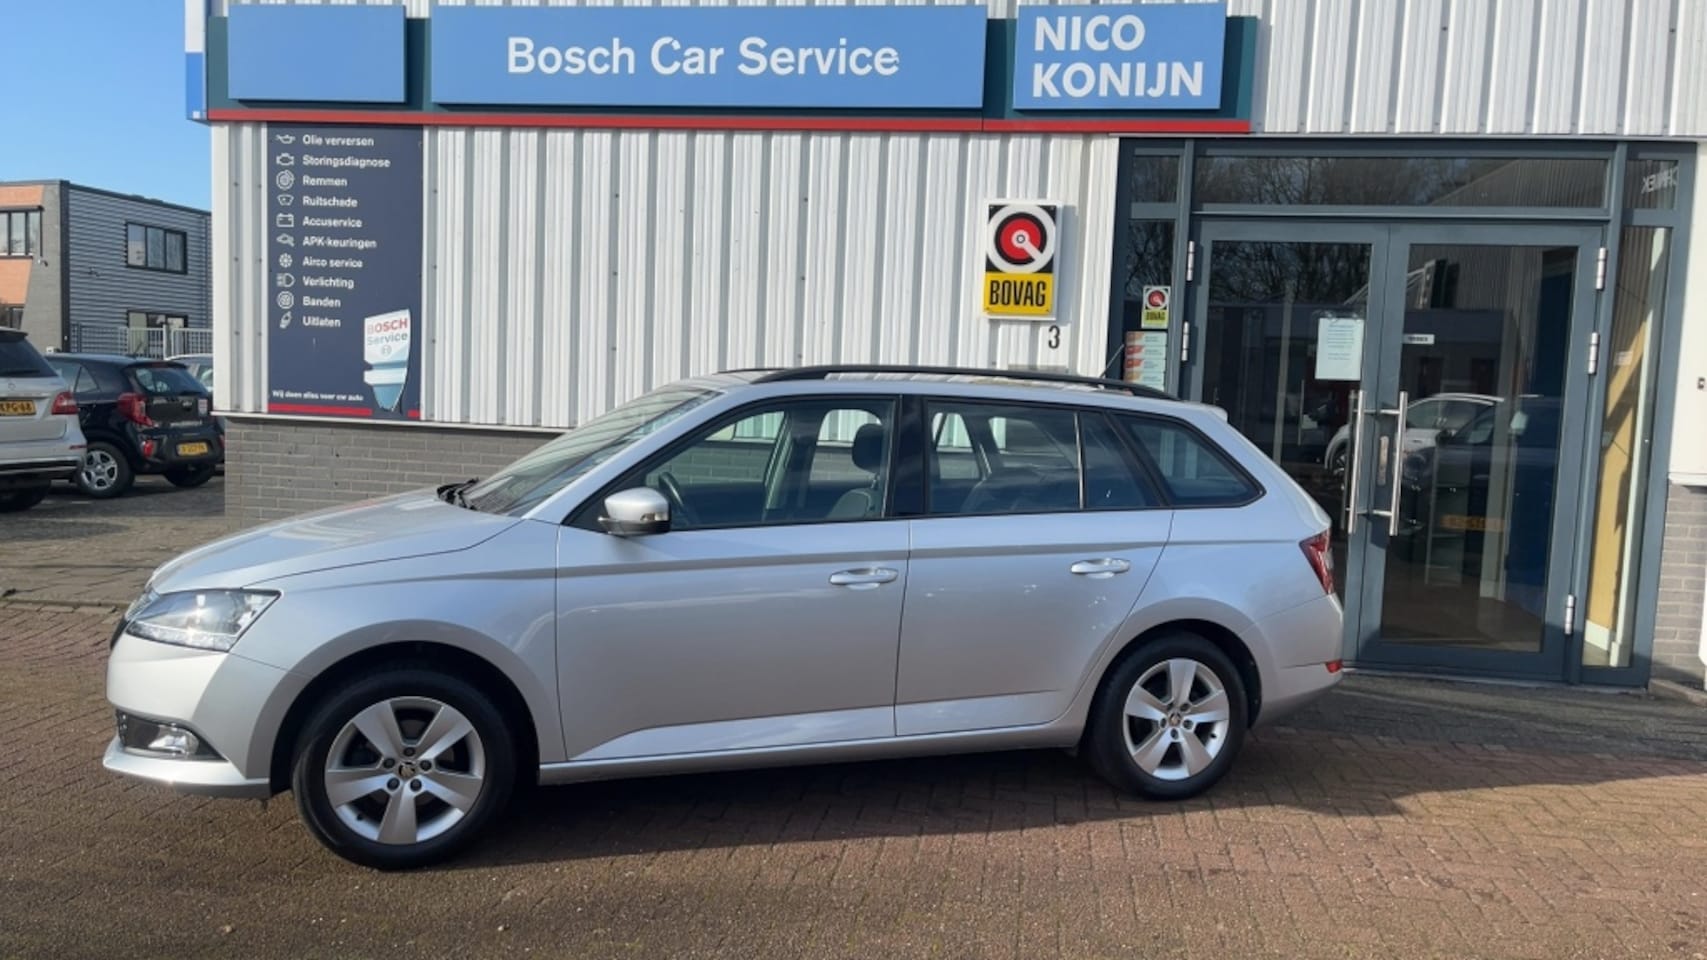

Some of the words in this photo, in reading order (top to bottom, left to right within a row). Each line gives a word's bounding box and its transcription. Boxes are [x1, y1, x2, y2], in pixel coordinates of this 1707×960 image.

[1034, 14, 1146, 52] NICO
[507, 36, 636, 74] Bosch
[650, 36, 725, 75] Car
[737, 36, 900, 75] Service
[1032, 61, 1204, 98] KONIJN
[302, 134, 323, 146] Olie
[325, 138, 374, 147] verversen
[302, 154, 391, 169] Storingsdiagnose
[302, 175, 348, 187] Remmen
[302, 196, 358, 208] Ruitschade
[302, 216, 363, 228] Accuservice
[302, 236, 377, 250] APK-keuringen
[302, 256, 328, 268] Airco
[329, 258, 363, 268] service
[302, 276, 355, 290] Verlichting
[989, 279, 1047, 307] BOVAG
[302, 296, 341, 308] Banden
[302, 316, 341, 328] Uitlaten
[367, 317, 408, 335] BOSCH
[367, 332, 408, 346] Service
[1048, 325, 1060, 349] 3
